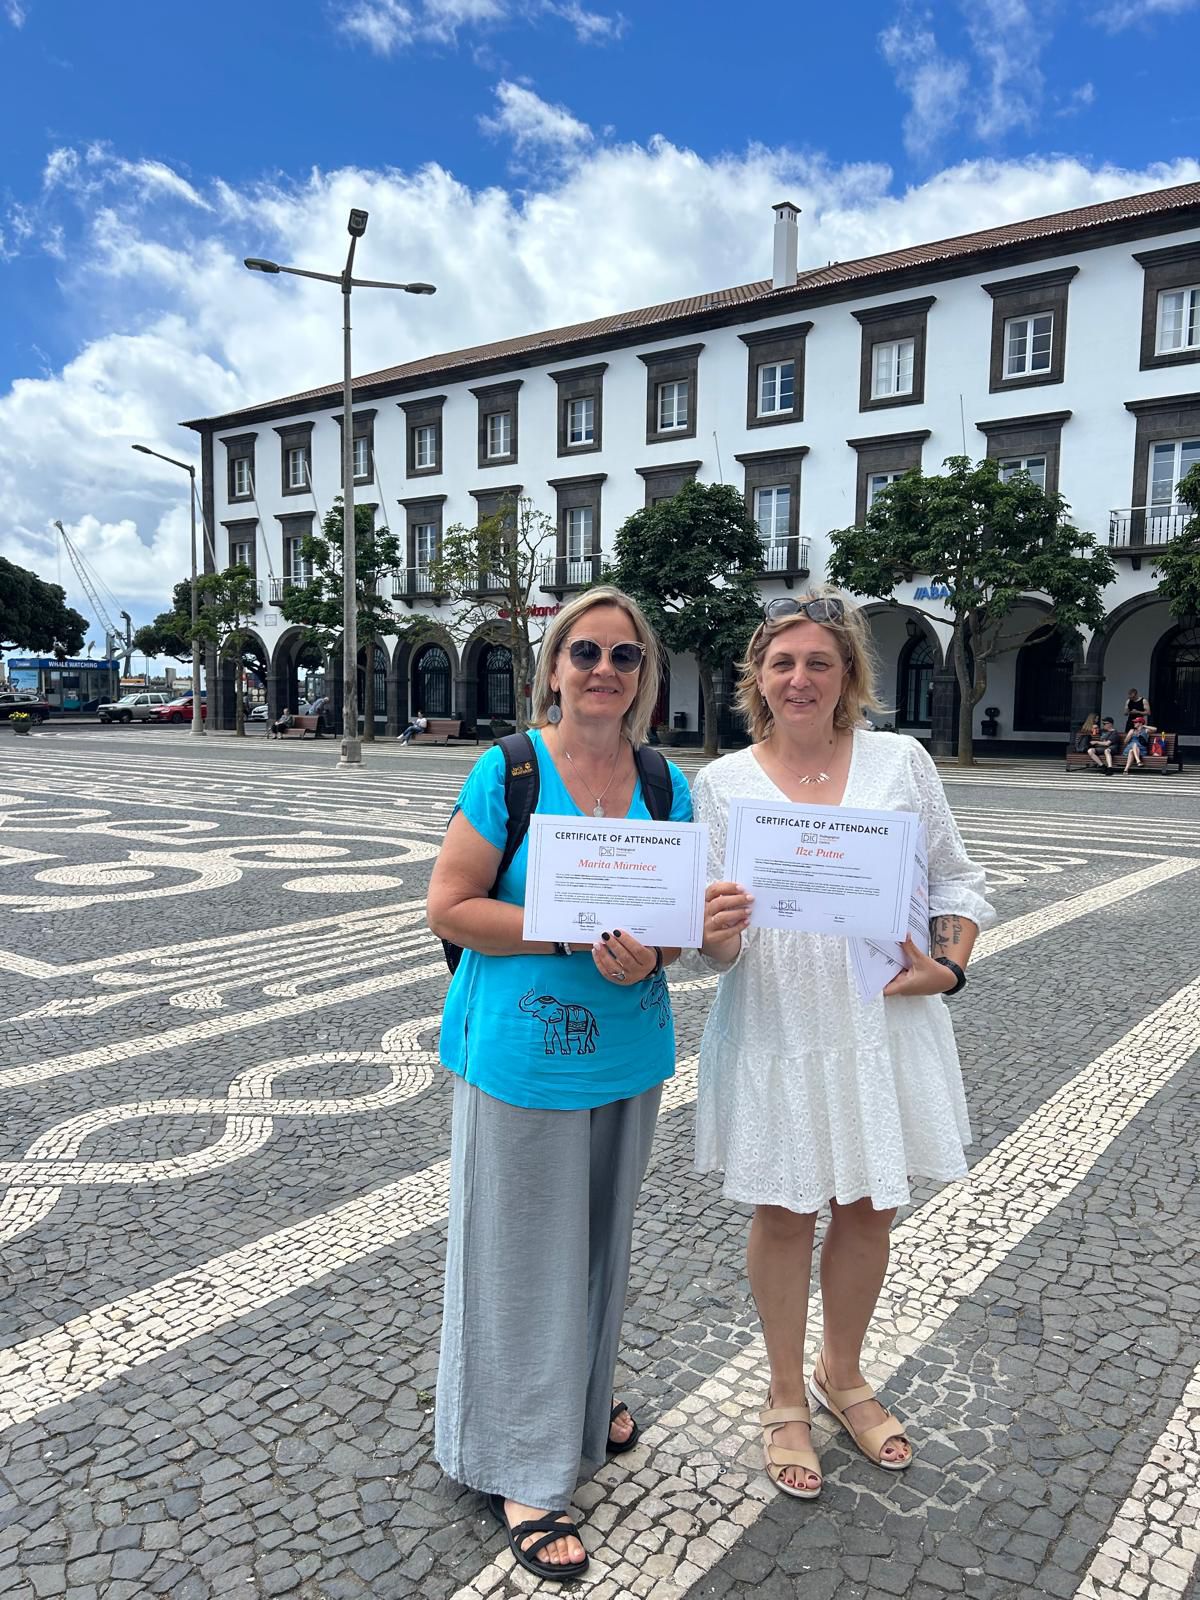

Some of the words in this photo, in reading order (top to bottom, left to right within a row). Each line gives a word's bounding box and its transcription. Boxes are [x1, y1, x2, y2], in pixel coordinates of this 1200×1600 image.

[755, 815, 810, 829] CERTIFICATE
[813, 820, 826, 830] OF
[828, 822, 889, 836] ATTENDANCE
[555, 831, 607, 842] CERTIFICATE
[609, 834, 623, 843] OF
[624, 835, 681, 846] ATTENDANCE
[796, 846, 814, 856] Ilze
[816, 848, 845, 860] Putne
[579, 859, 611, 869] Marita
